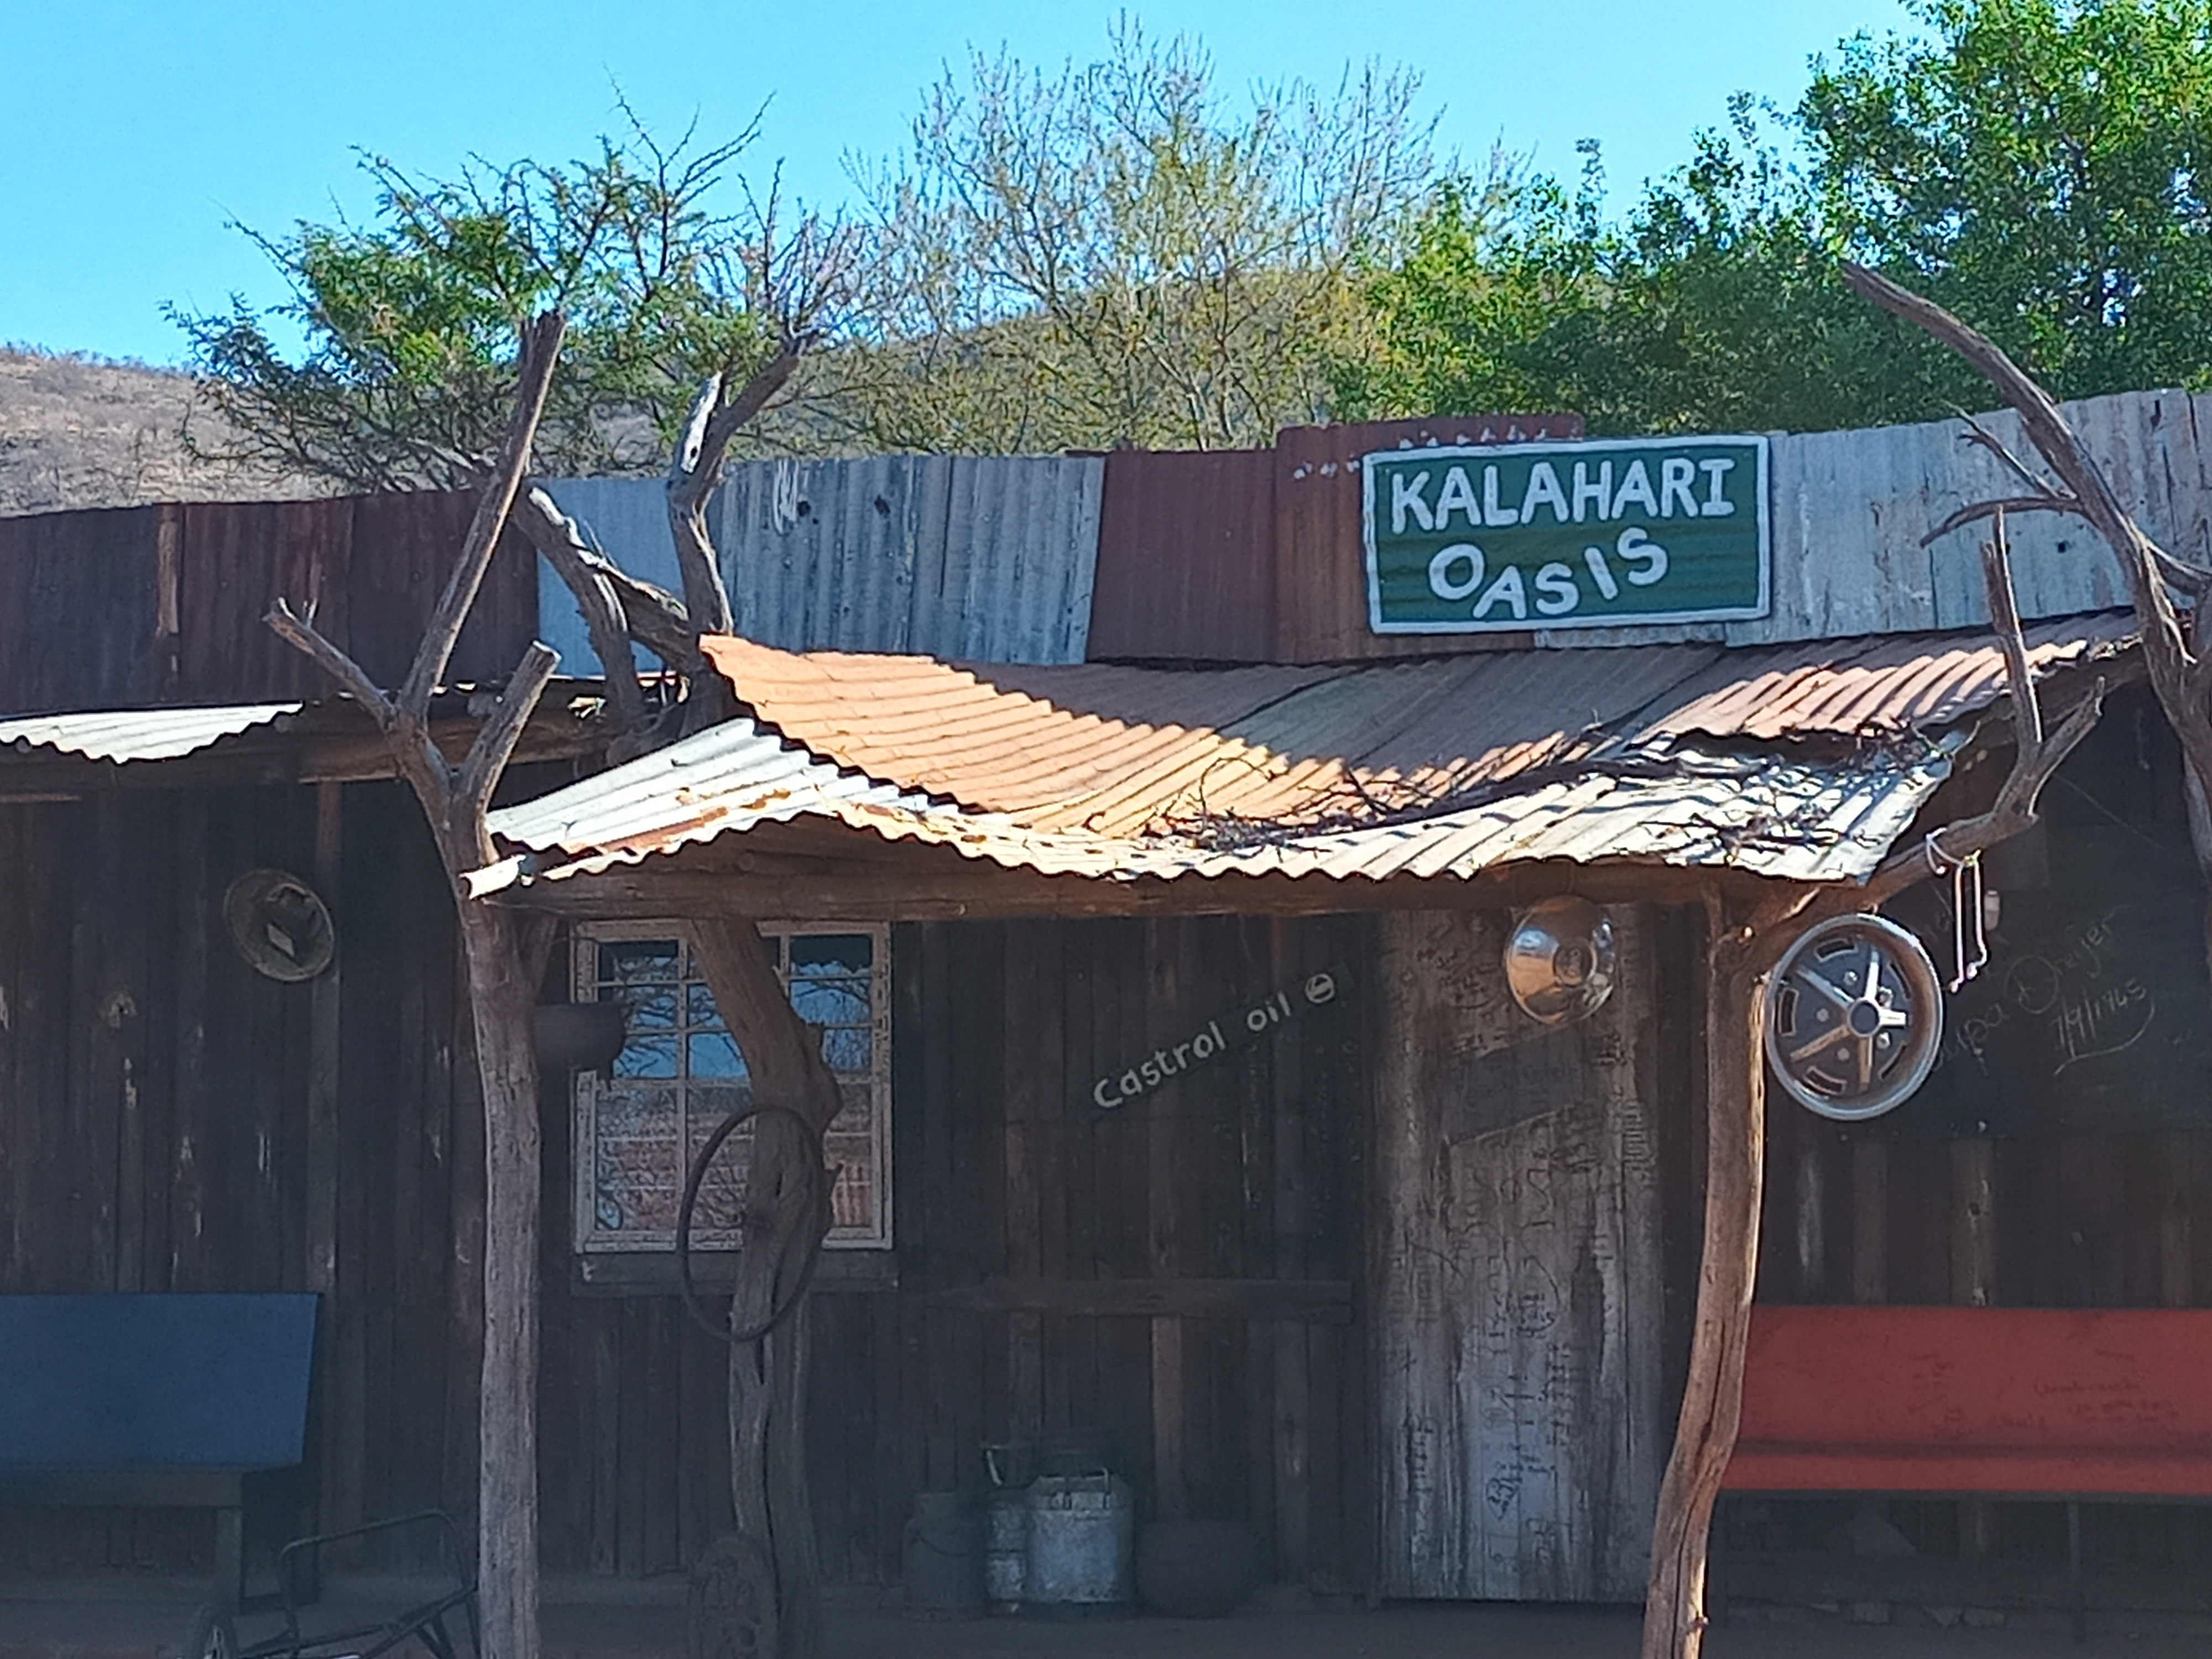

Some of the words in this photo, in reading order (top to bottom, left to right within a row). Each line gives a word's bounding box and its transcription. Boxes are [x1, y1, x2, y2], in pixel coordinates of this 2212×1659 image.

[1391, 457, 1735, 534] KALAHARI
[1429, 528, 1667, 619] OASIS
[1094, 1020, 1226, 1107] Castrol
[1247, 990, 1291, 1031] oil
